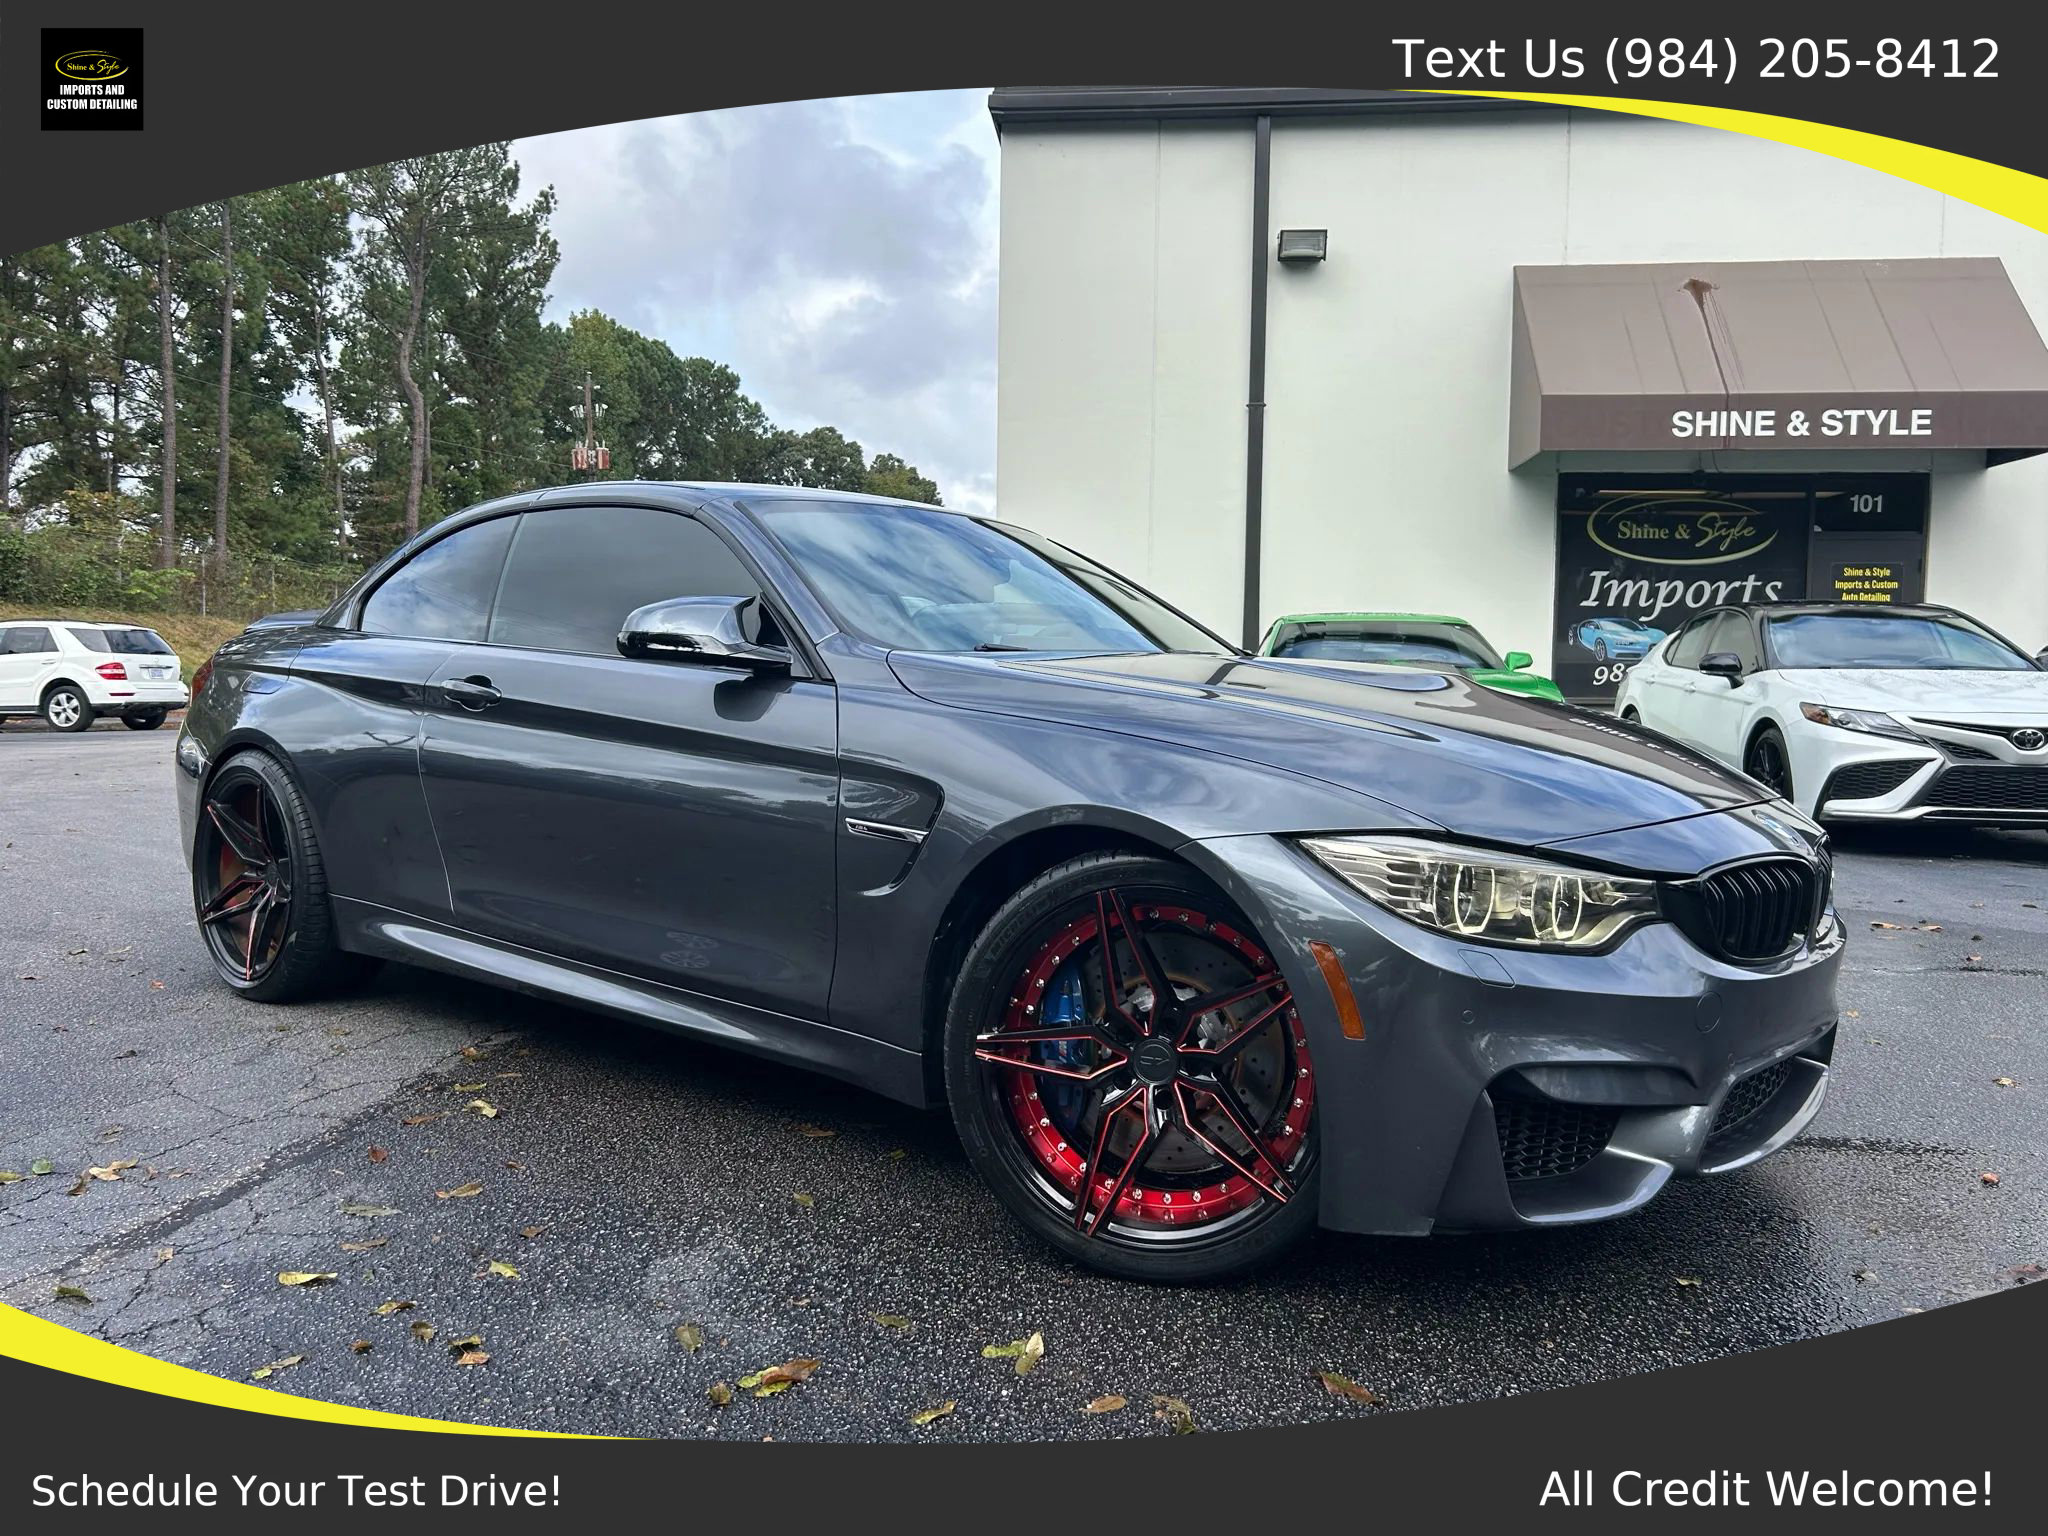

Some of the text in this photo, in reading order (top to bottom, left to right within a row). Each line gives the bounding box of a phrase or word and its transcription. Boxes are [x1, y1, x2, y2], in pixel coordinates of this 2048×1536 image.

[1671, 411, 1776, 438] SHINE
[1786, 411, 1810, 437] &
[1821, 409, 1932, 436] STYLE
[1850, 494, 1883, 513] 101
[1617, 512, 1756, 551] Shine & Style
[1843, 567, 1891, 578] Shine & Style
[1835, 580, 1898, 590] Imports & Custom
[1579, 570, 1783, 622] Imports
[1841, 592, 1891, 602] Auto Detailing
[1592, 662, 1633, 686] 98
